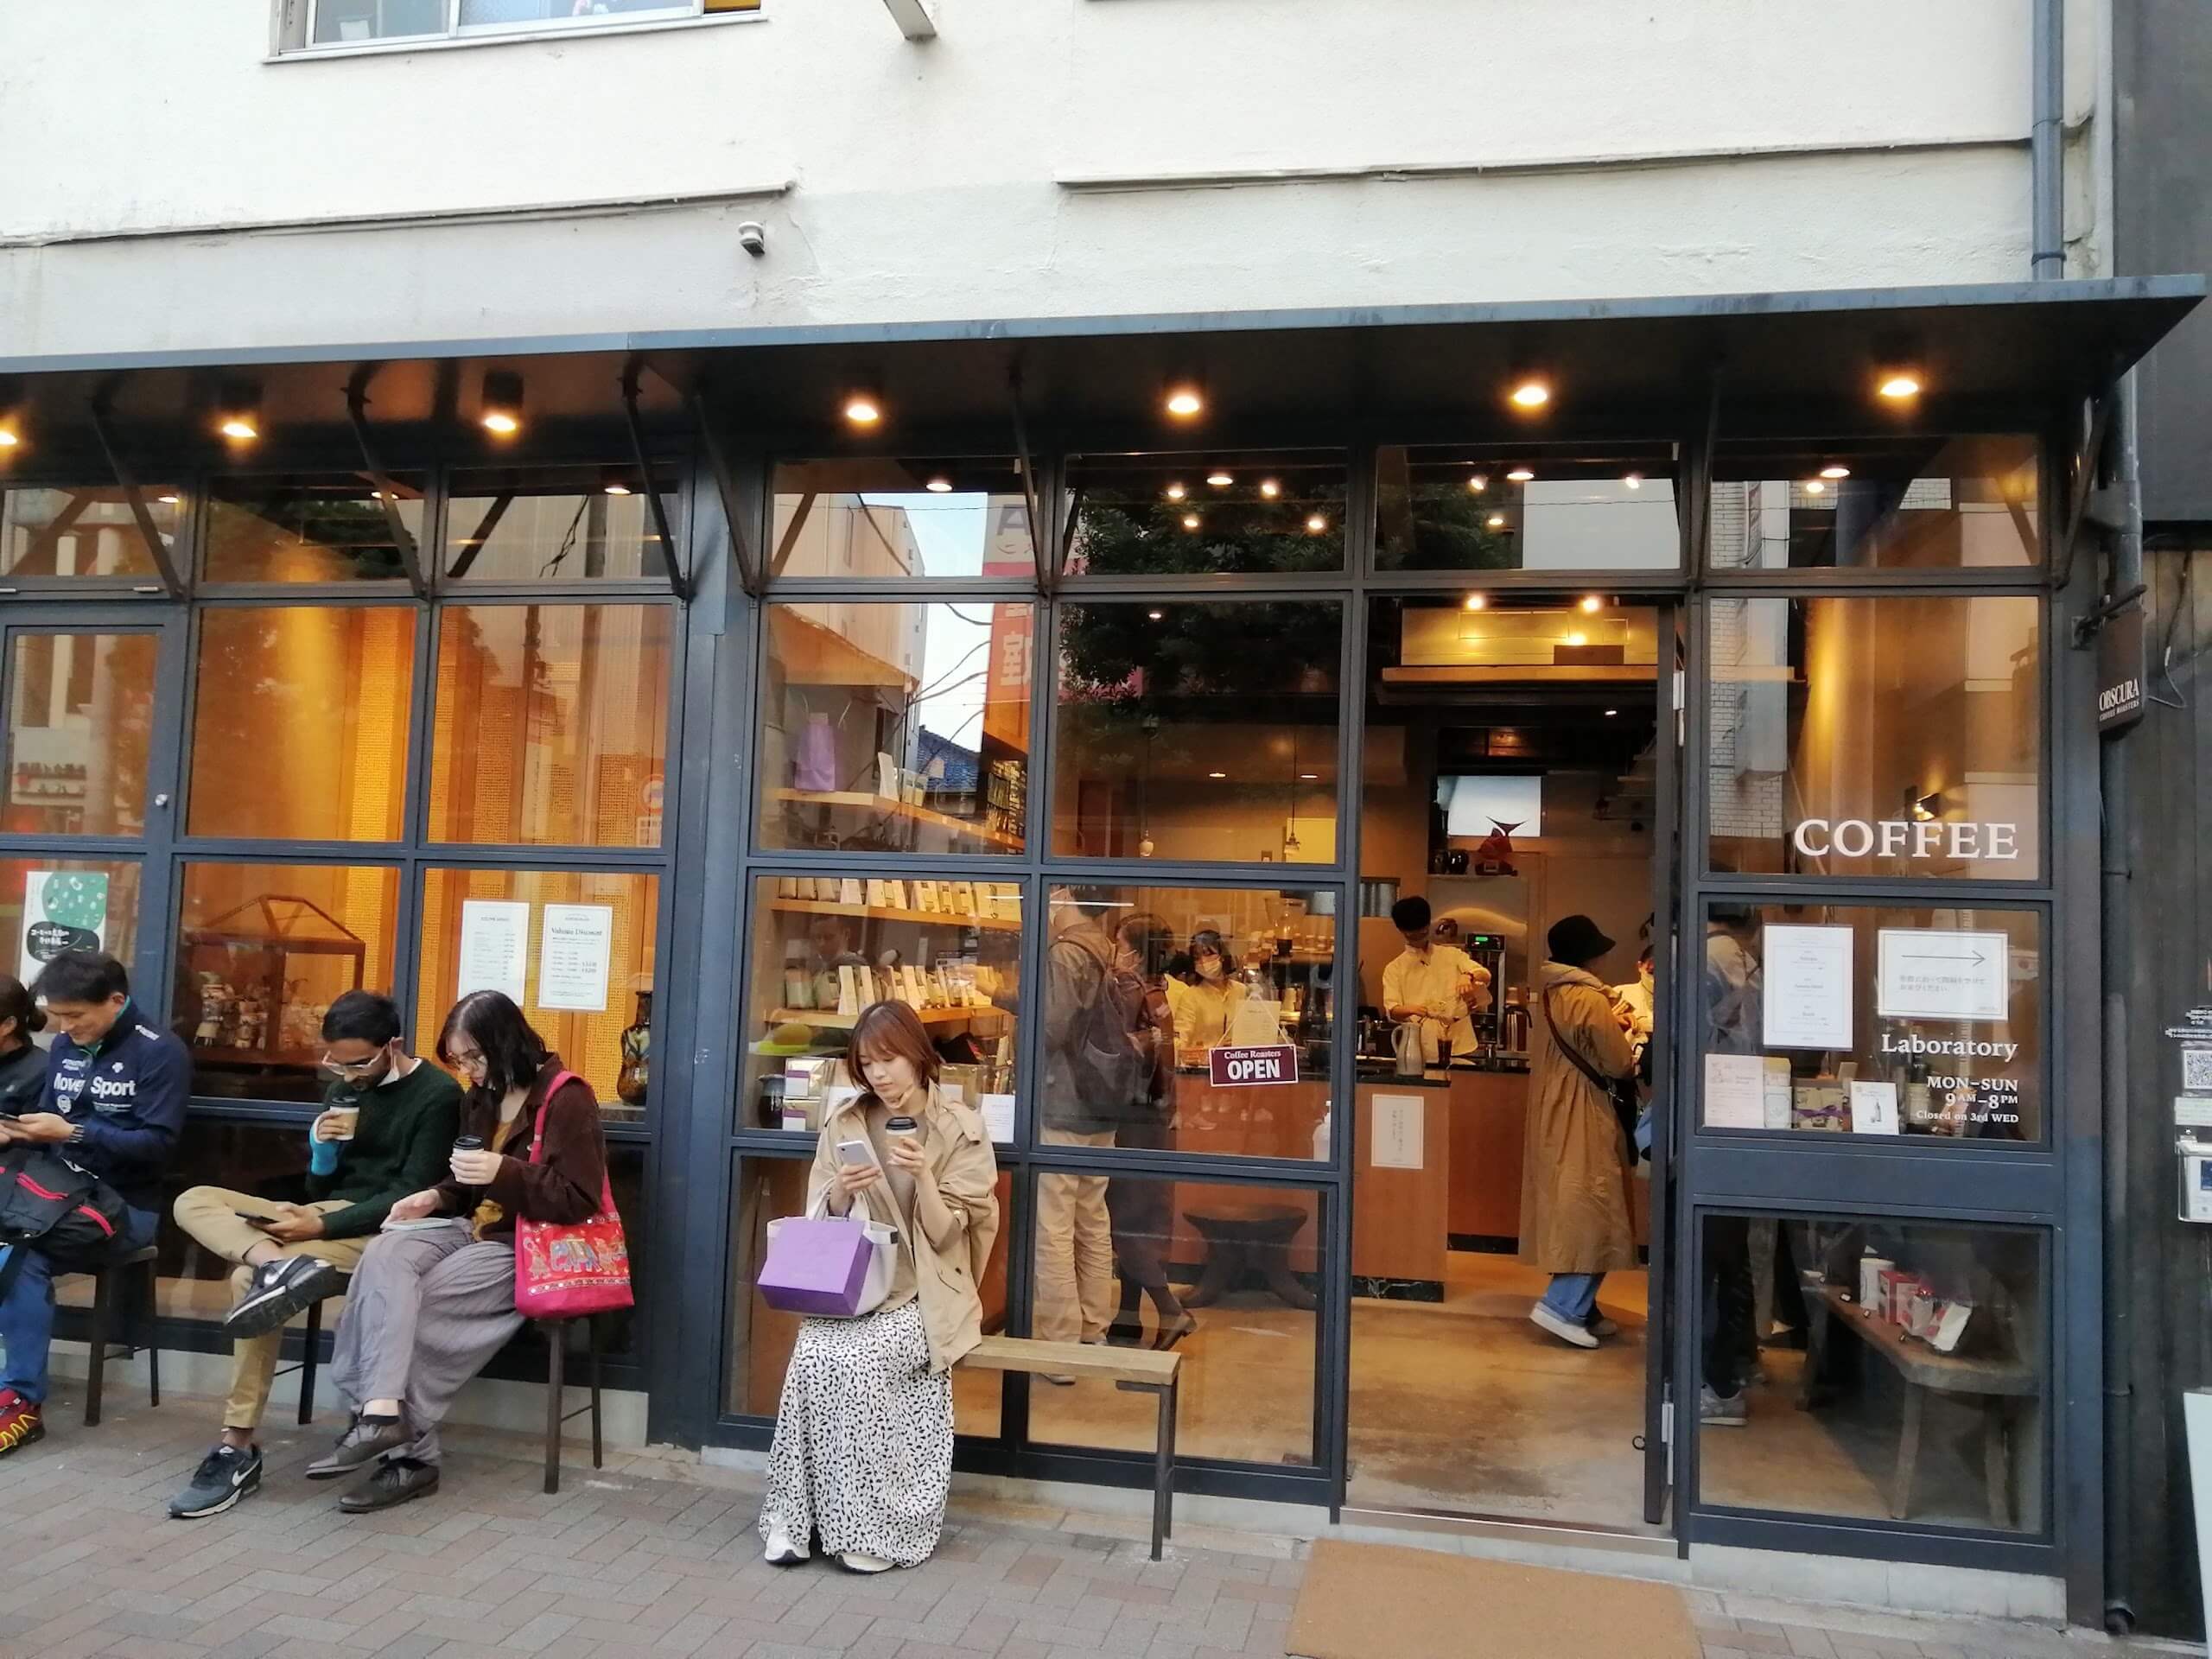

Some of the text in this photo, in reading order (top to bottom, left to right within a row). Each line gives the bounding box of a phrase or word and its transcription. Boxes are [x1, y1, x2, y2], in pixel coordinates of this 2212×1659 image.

[2100, 677, 2139, 711] OBSCURA
[1794, 819, 2019, 859] COFFEE
[1224, 1050, 1281, 1059] Coffee Roasters
[1881, 1033, 2018, 1063] Laboratory
[1227, 1059, 1281, 1080] OPEN
[90, 1076, 137, 1099] Sport
[1916, 1110, 1951, 1121] Closed
[1970, 1113, 1988, 1122] 3rd
[1991, 1114, 2019, 1123] WED
